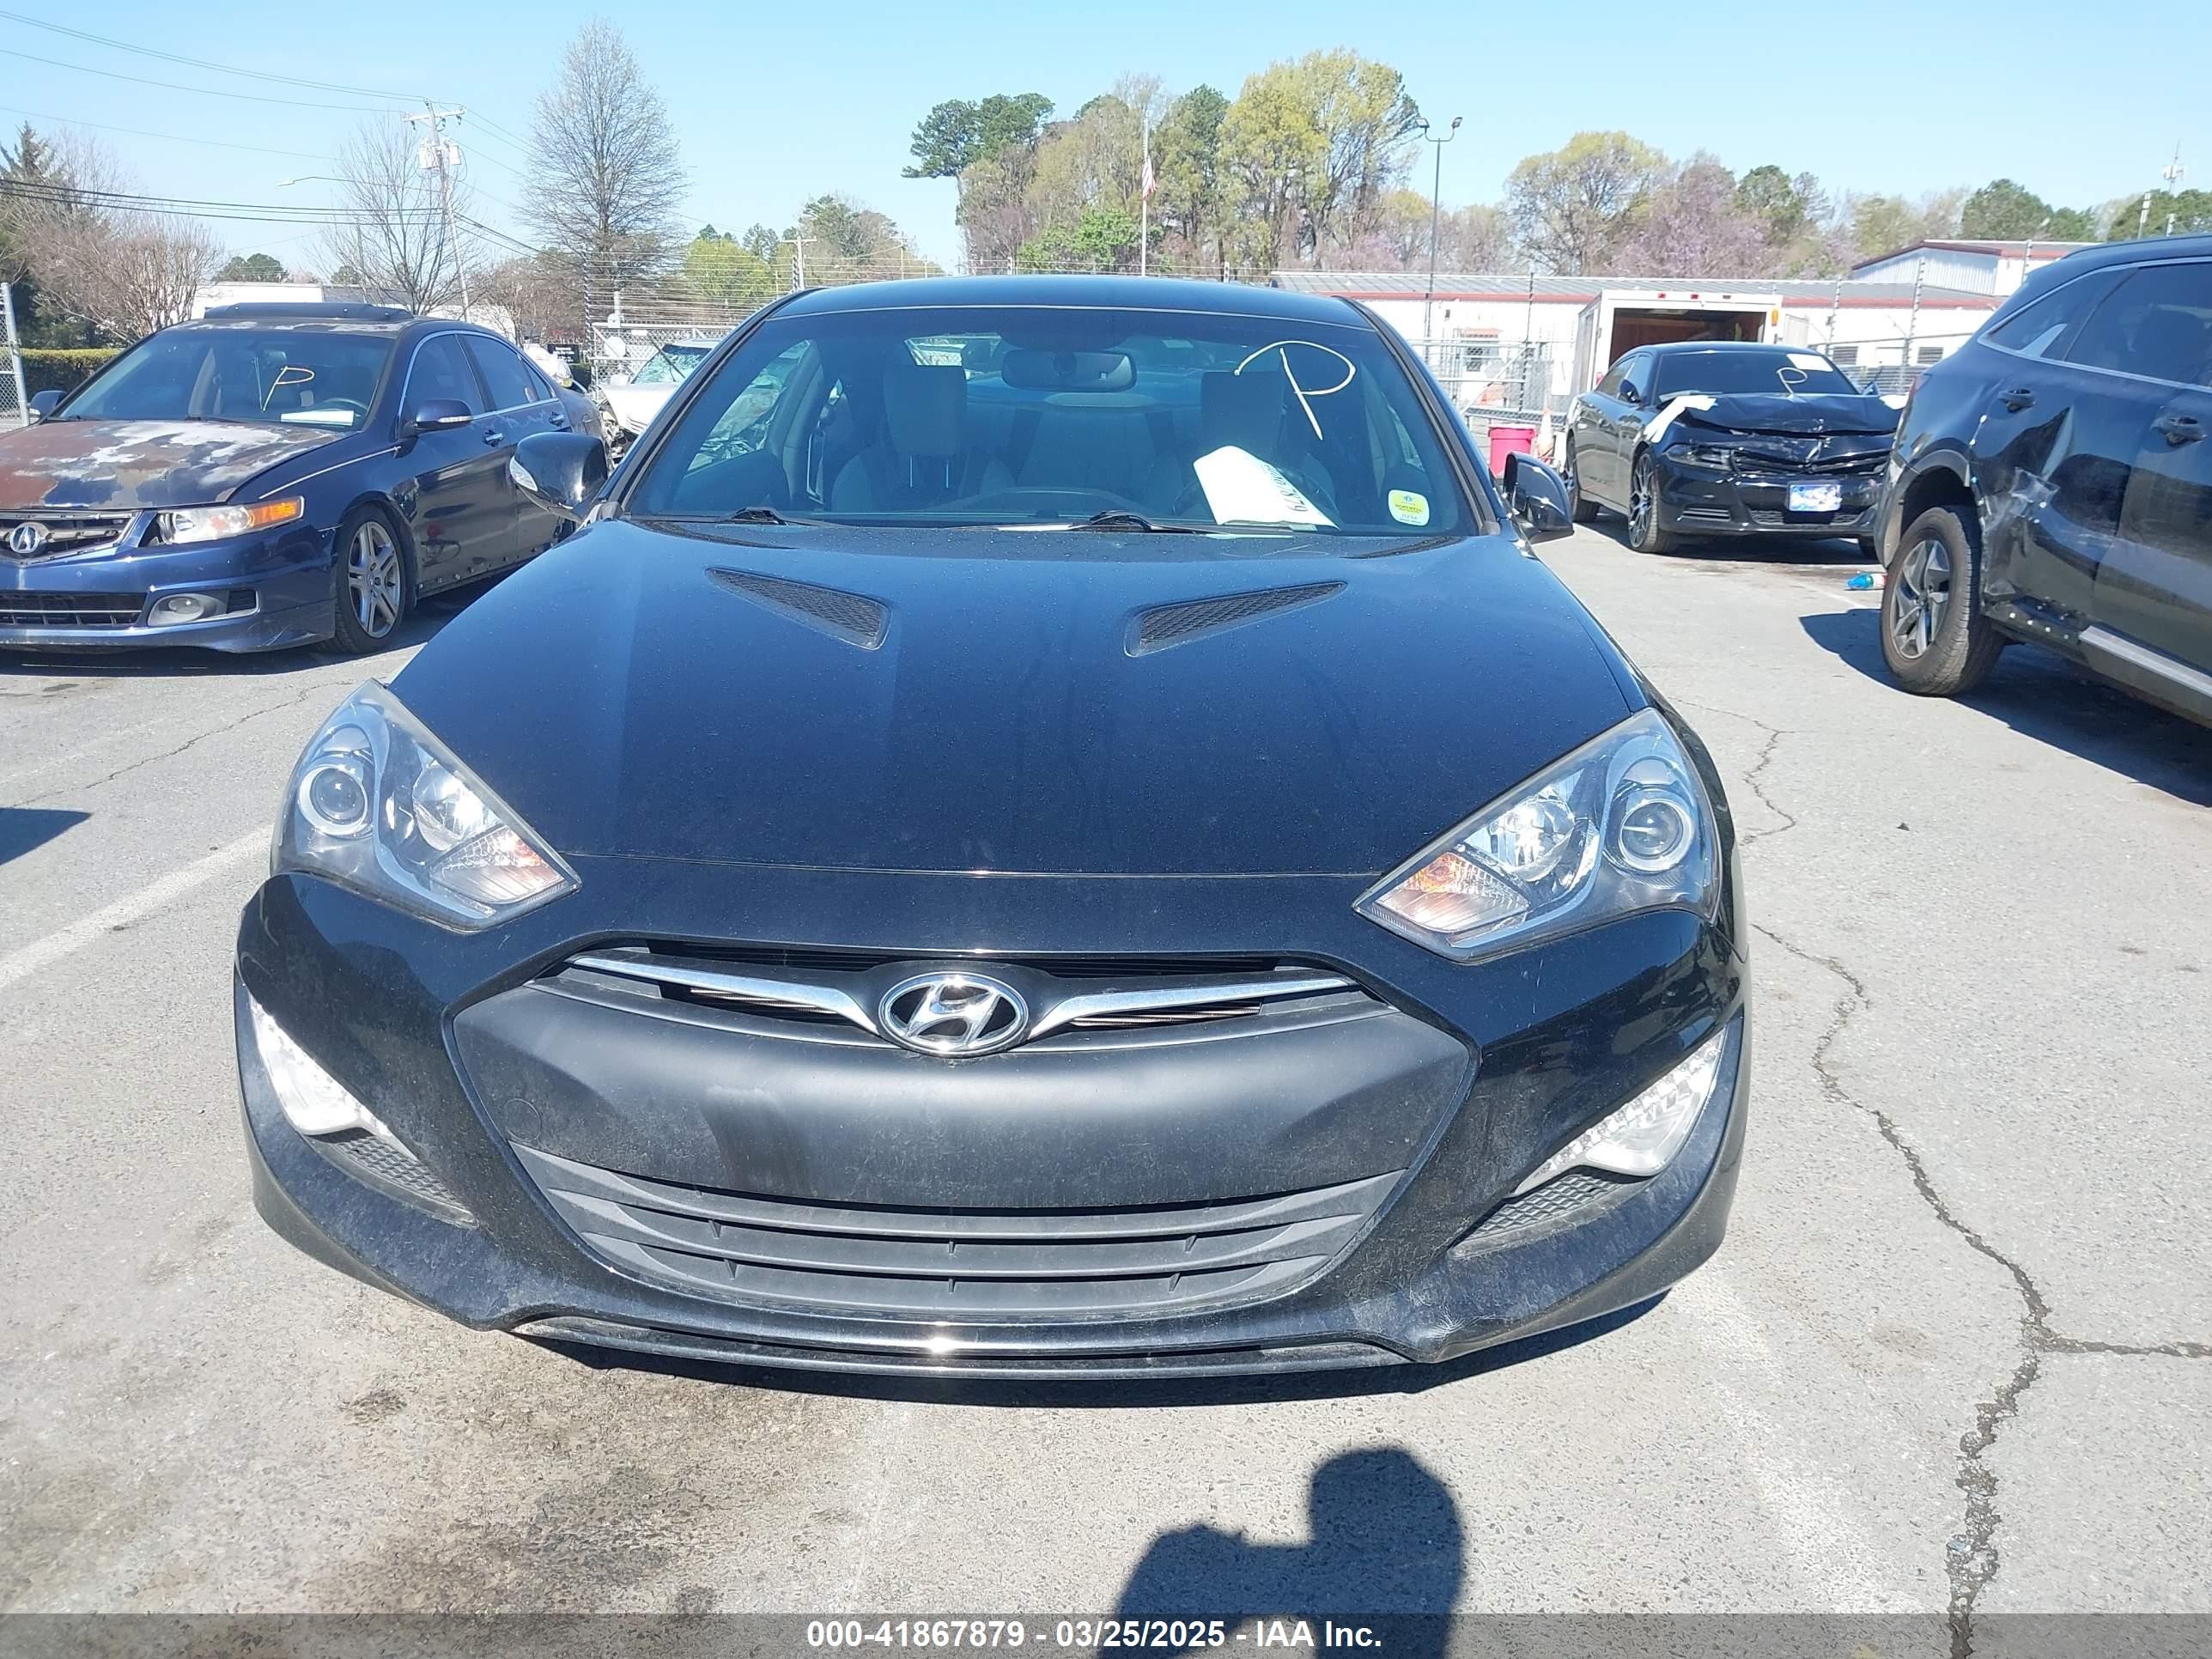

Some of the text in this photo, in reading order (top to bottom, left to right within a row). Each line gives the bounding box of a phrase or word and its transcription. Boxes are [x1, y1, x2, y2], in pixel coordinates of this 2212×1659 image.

[262, 366, 315, 411] P
[1234, 340, 1357, 441] P
[1776, 367, 1808, 394] P
